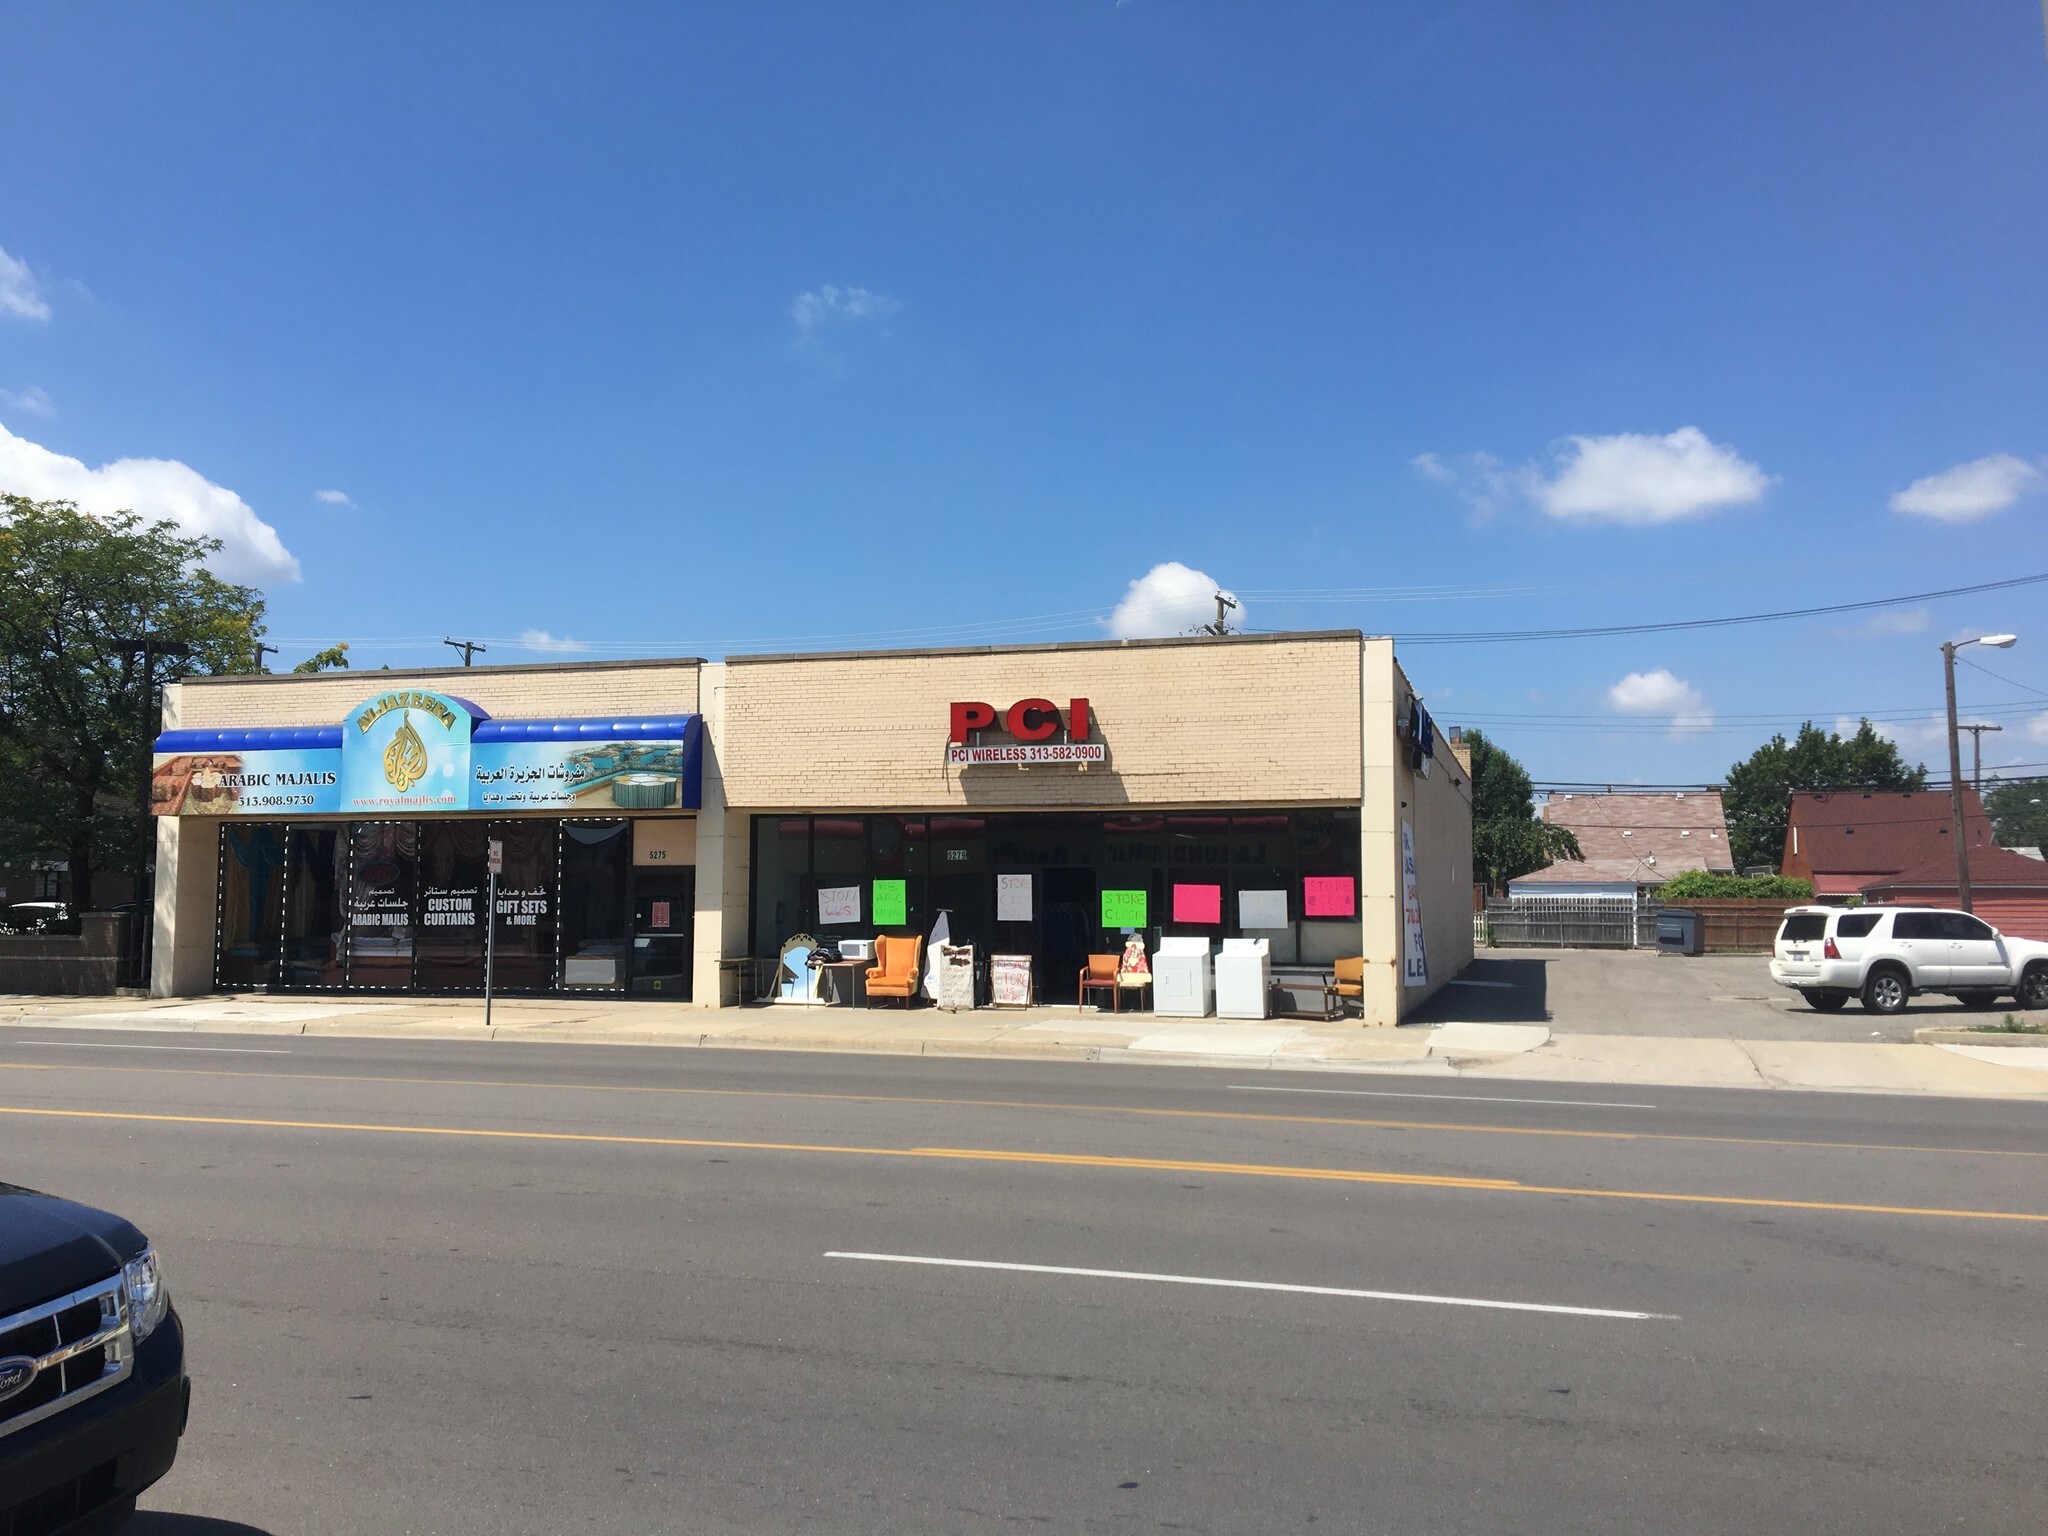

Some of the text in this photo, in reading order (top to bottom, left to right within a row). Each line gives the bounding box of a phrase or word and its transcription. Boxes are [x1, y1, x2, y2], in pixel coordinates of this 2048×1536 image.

[950, 698, 1089, 742] PCI
[952, 746, 1101, 762] PCI WIRELESS 313-582-0900
[219, 772, 336, 787] ARABIC MAJALIS
[476, 762, 585, 784] مفروشات الجزيرة العربية
[239, 795, 314, 806] 313.908.9730
[353, 795, 456, 807] www.royalmajlis.com
[649, 851, 666, 859] 5275
[947, 851, 966, 860] 5279
[354, 896, 408, 910] جلسات عربية
[428, 898, 471, 911] CUSTOM
[1105, 894, 1144, 905] STORE
[496, 900, 547, 913] GIFT SETS
[352, 914, 408, 925] ARABIC MAJLIS
[424, 912, 475, 925] CURTAINS
[506, 915, 536, 925] & MORE
[995, 973, 1028, 987] STORE
